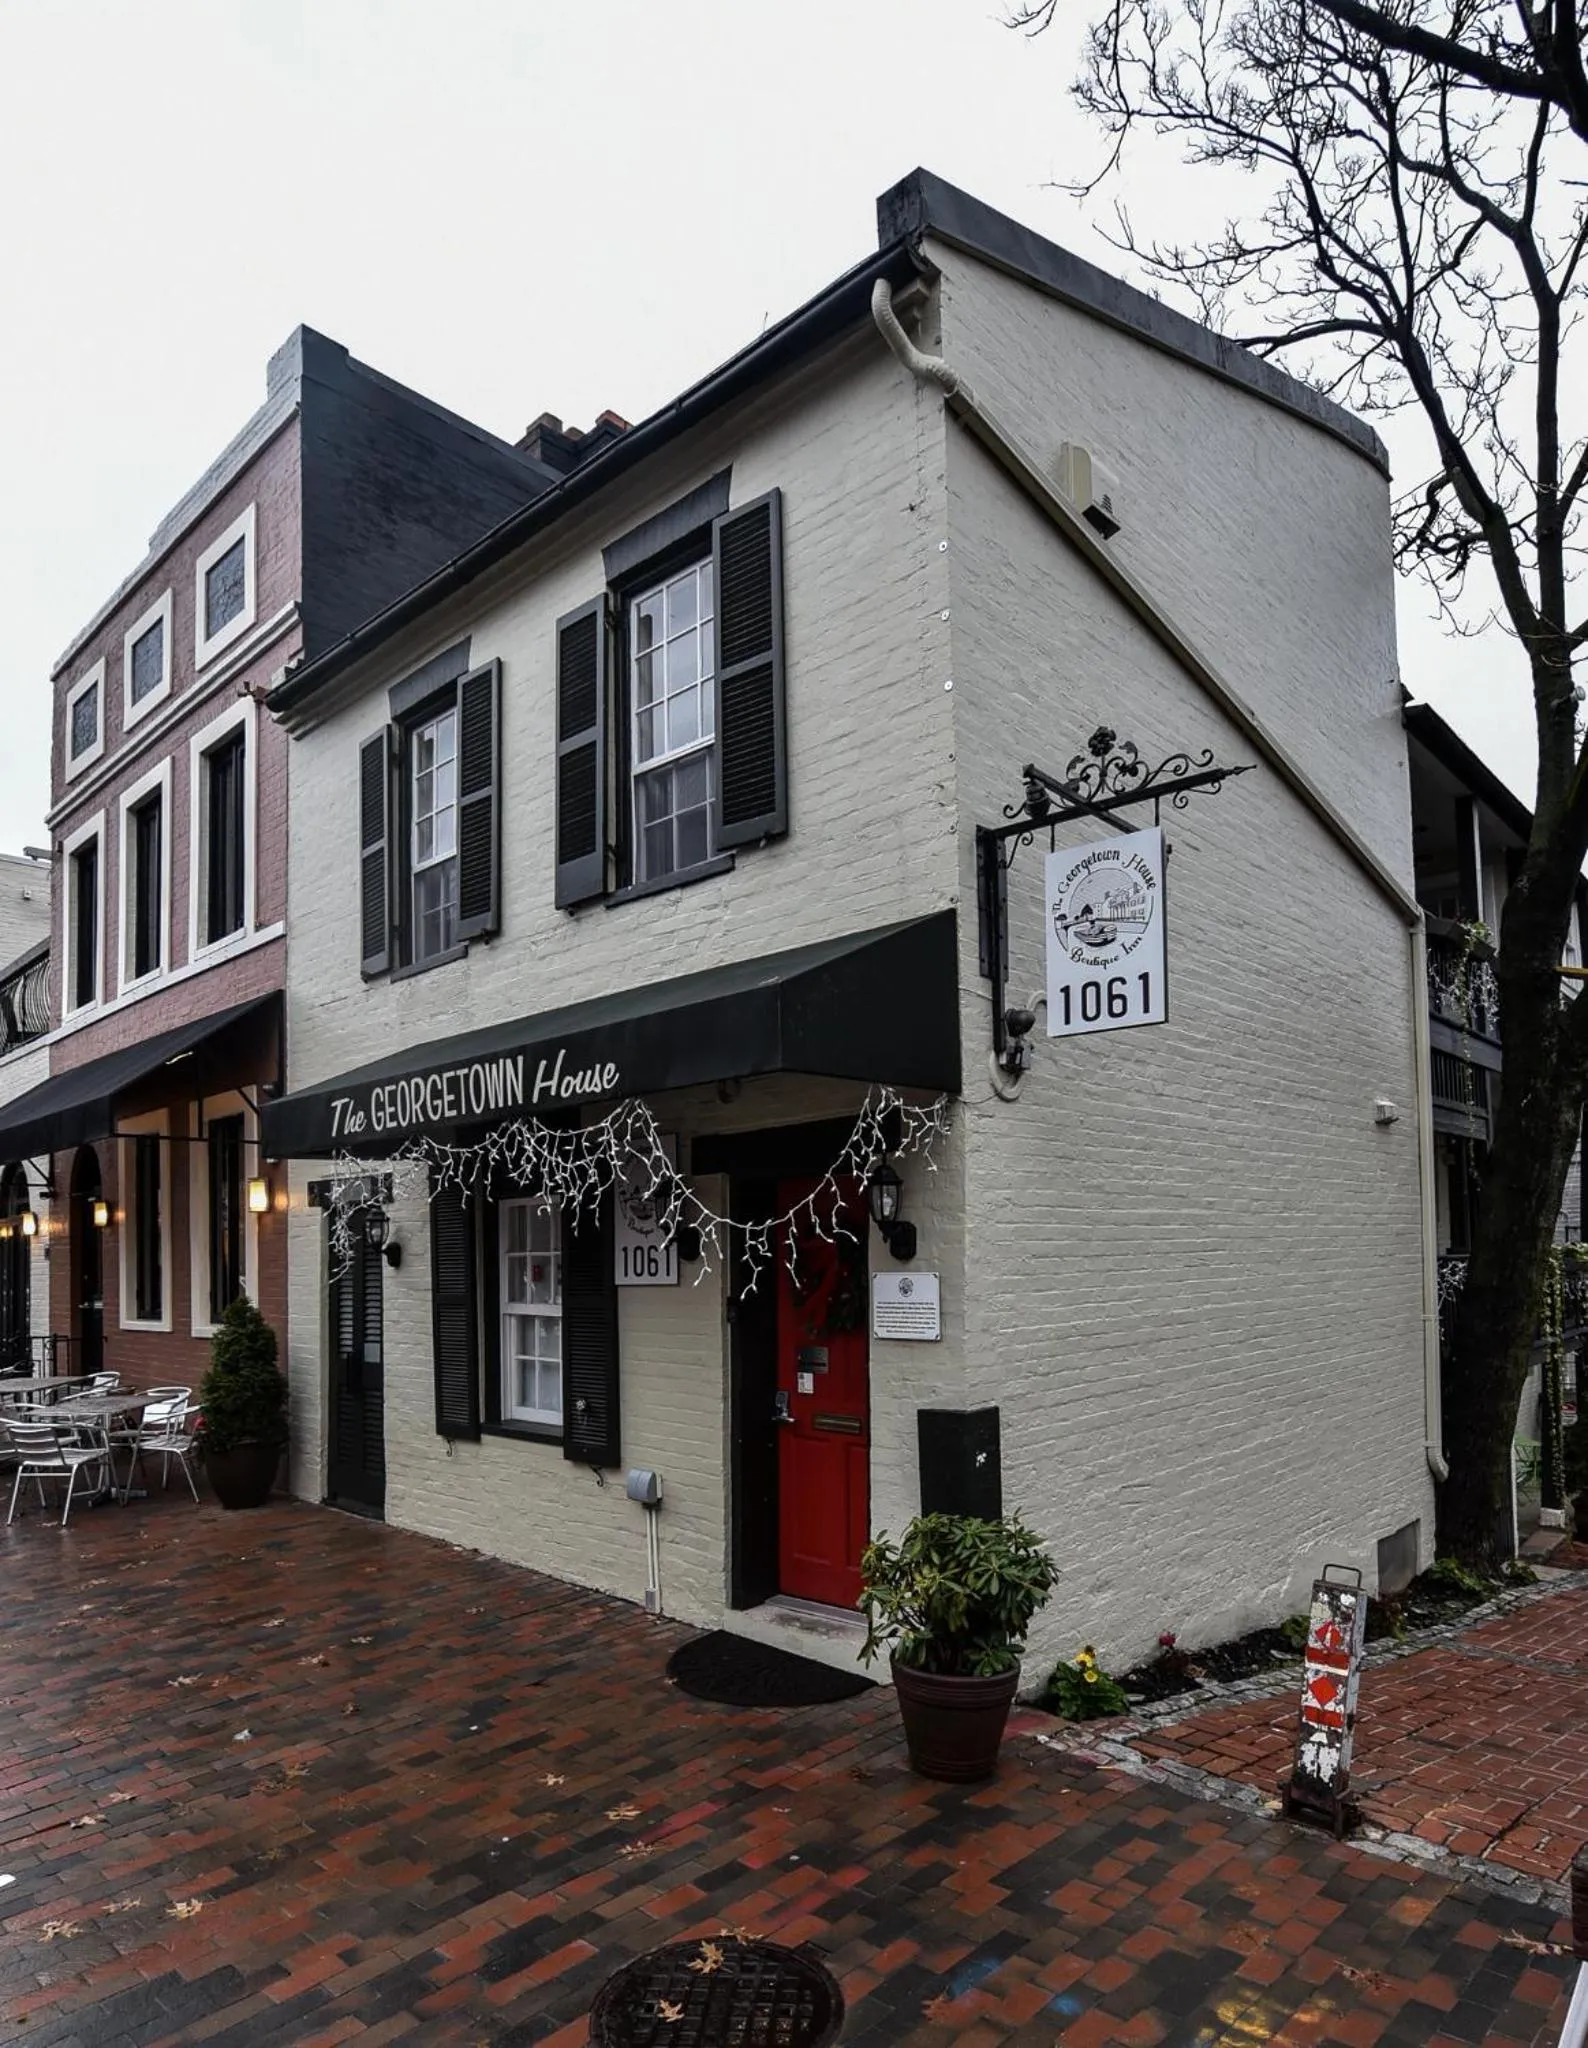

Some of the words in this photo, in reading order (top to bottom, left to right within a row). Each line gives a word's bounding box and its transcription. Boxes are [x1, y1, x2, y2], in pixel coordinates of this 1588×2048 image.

[1057, 849, 1121, 894] Georgetown
[1121, 853, 1156, 890] House
[1070, 946, 1119, 970] Boutique
[1121, 936, 1143, 955] Inn
[1059, 971, 1150, 1026] 1061
[330, 1096, 367, 1137] The
[370, 1054, 525, 1132] GEORGETOWN
[532, 1048, 620, 1104] House
[622, 1244, 671, 1278] 1061
